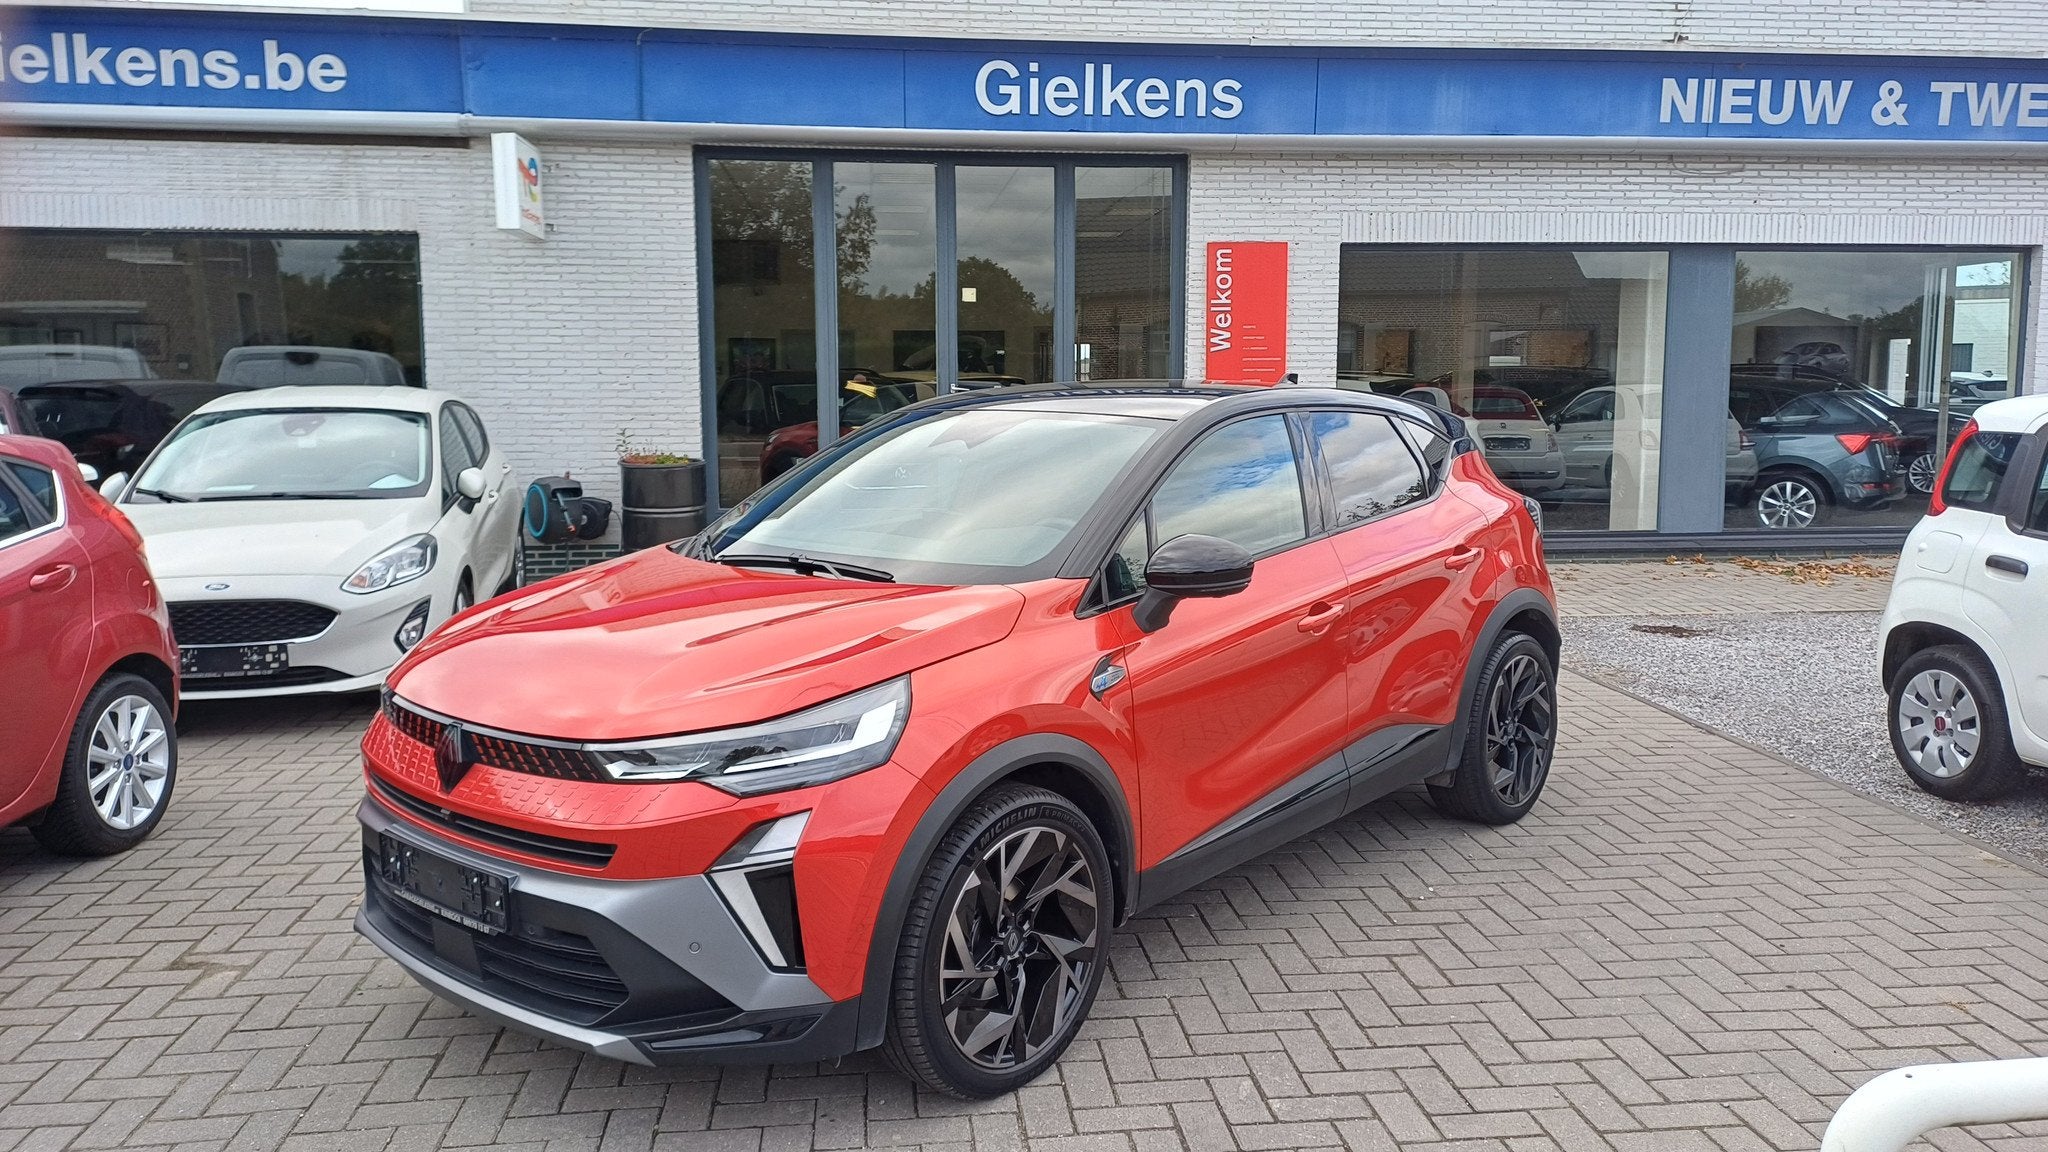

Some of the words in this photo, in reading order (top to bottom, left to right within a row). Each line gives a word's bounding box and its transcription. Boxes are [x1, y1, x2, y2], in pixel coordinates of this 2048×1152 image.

[975, 59, 1243, 120] Gielkens
[1659, 77, 1853, 125] NIEUW
[1870, 80, 1909, 126] &
[1930, 81, 2048, 127] TWE
[1210, 248, 1233, 353] Welkom
[980, 806, 1037, 849] MICHELIN
